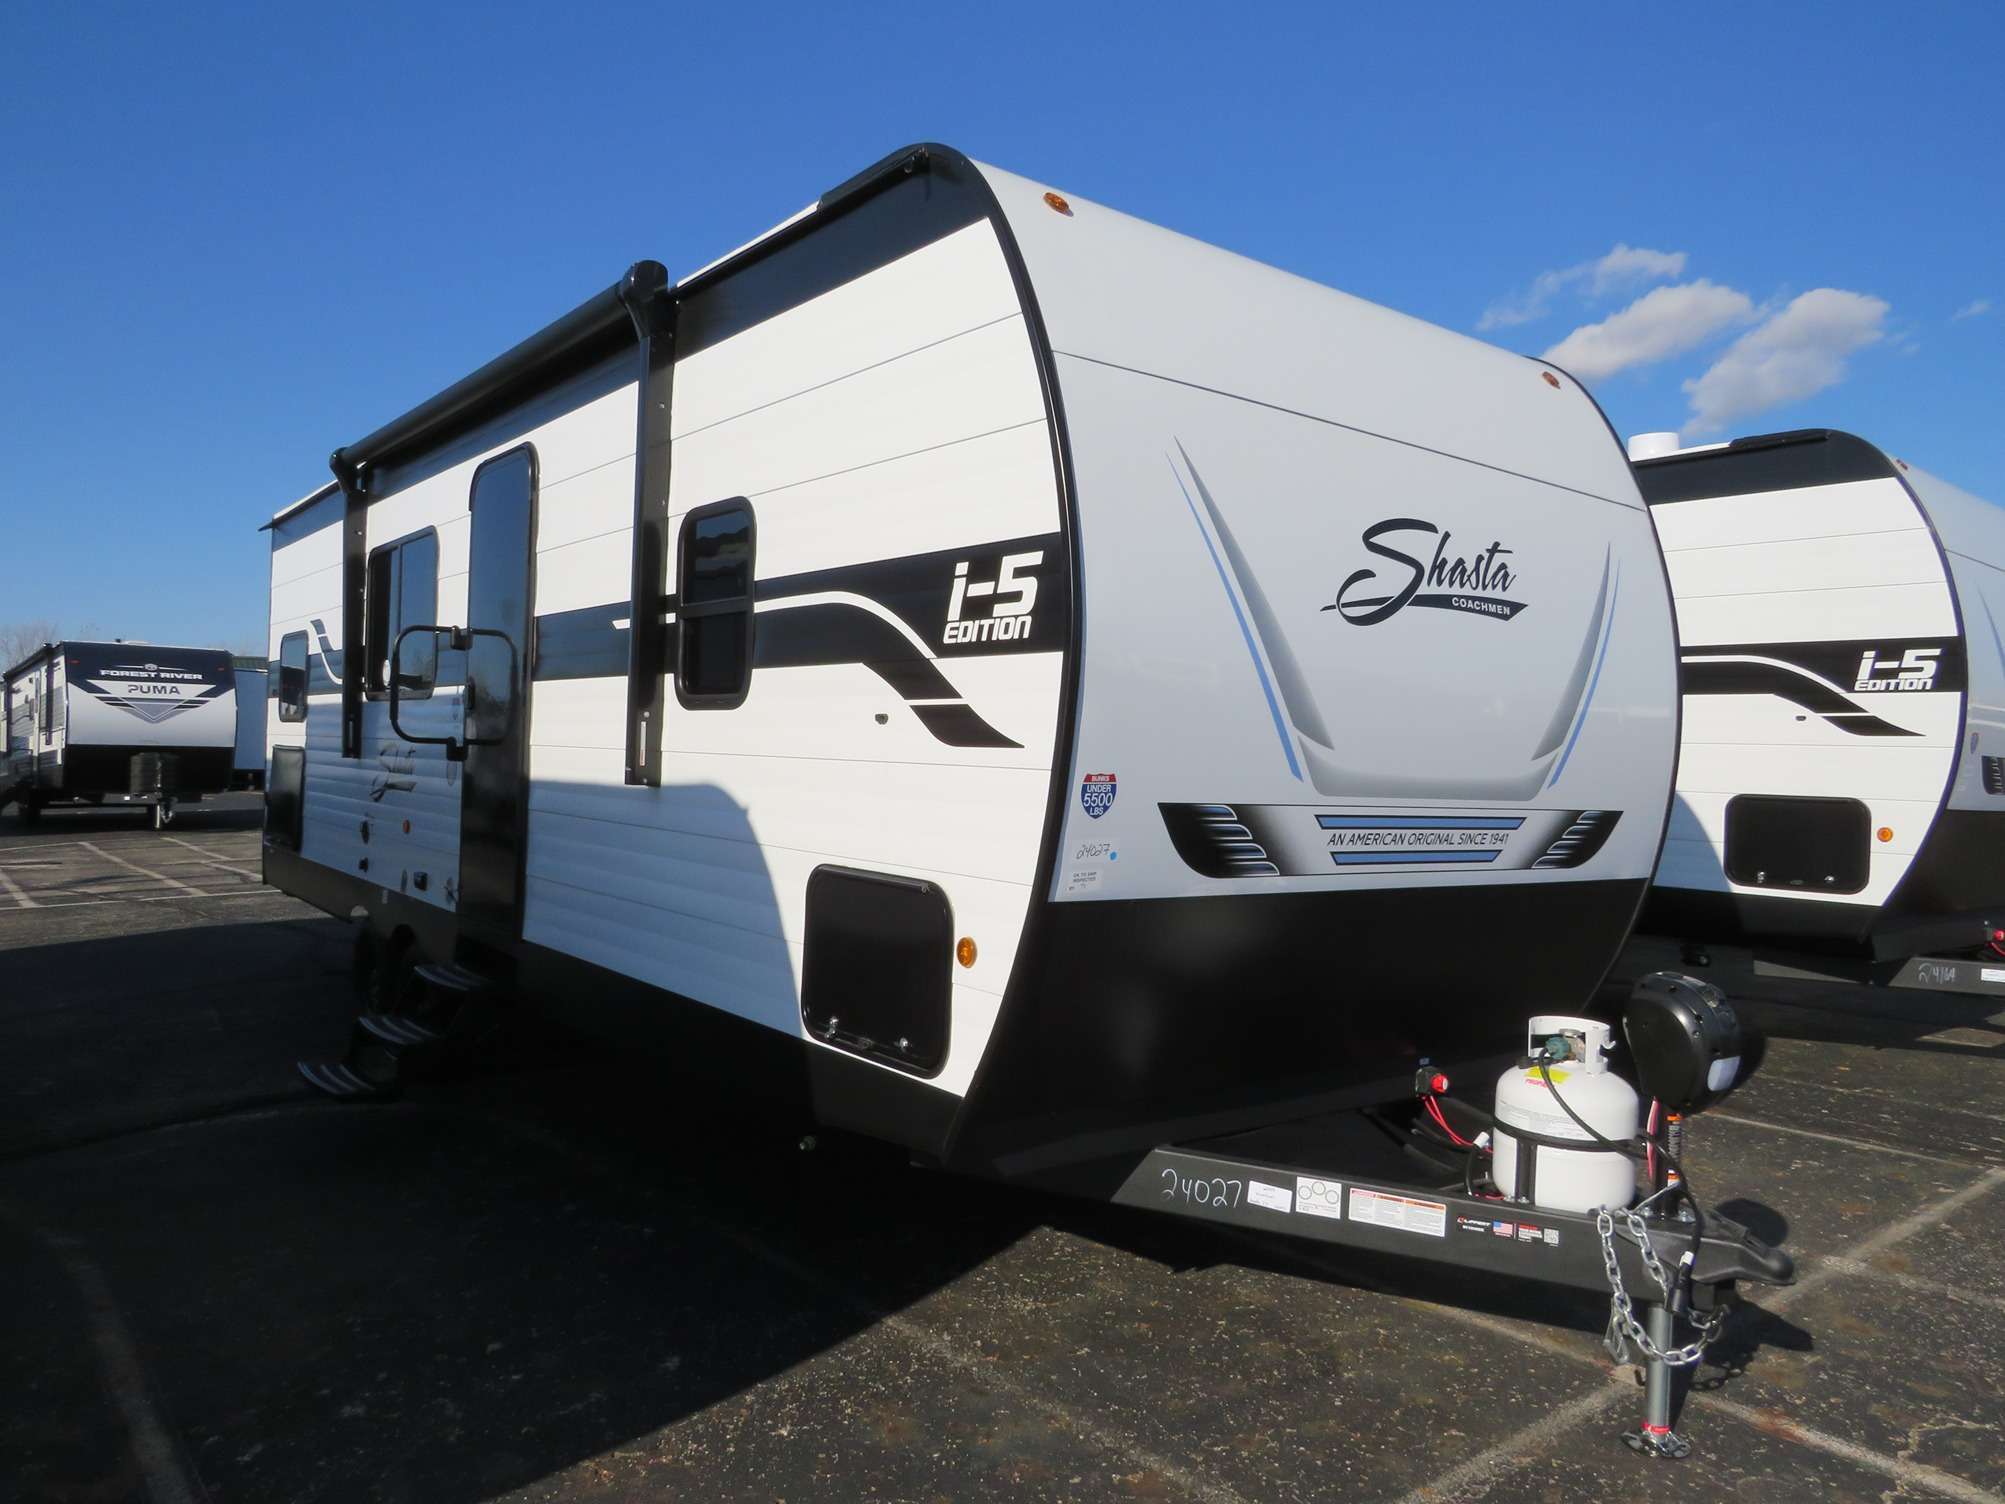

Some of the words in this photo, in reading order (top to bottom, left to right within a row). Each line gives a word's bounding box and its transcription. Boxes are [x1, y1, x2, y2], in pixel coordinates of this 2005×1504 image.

[1336, 518, 1517, 626] Shasta
[947, 550, 1044, 622] i-5
[1452, 597, 1511, 616] COACHMEN
[943, 615, 1032, 644] EDITION
[1856, 648, 1942, 680] i-5
[100, 669, 158, 678] FOREST
[160, 671, 203, 680] RIVER
[128, 684, 180, 695] PUMA
[1854, 678, 1933, 691] EDITION
[1086, 784, 1112, 793] UNDER
[1083, 792, 1113, 807] 5500
[1089, 806, 1104, 816] LBS
[1327, 833, 1347, 846] AN
[1347, 833, 1406, 846] AMERICAN
[1407, 832, 1455, 846] ORIGINAL
[1458, 832, 1489, 845] SINCE
[1489, 833, 1509, 845] 1941
[1161, 1168, 1242, 1207] 24027
